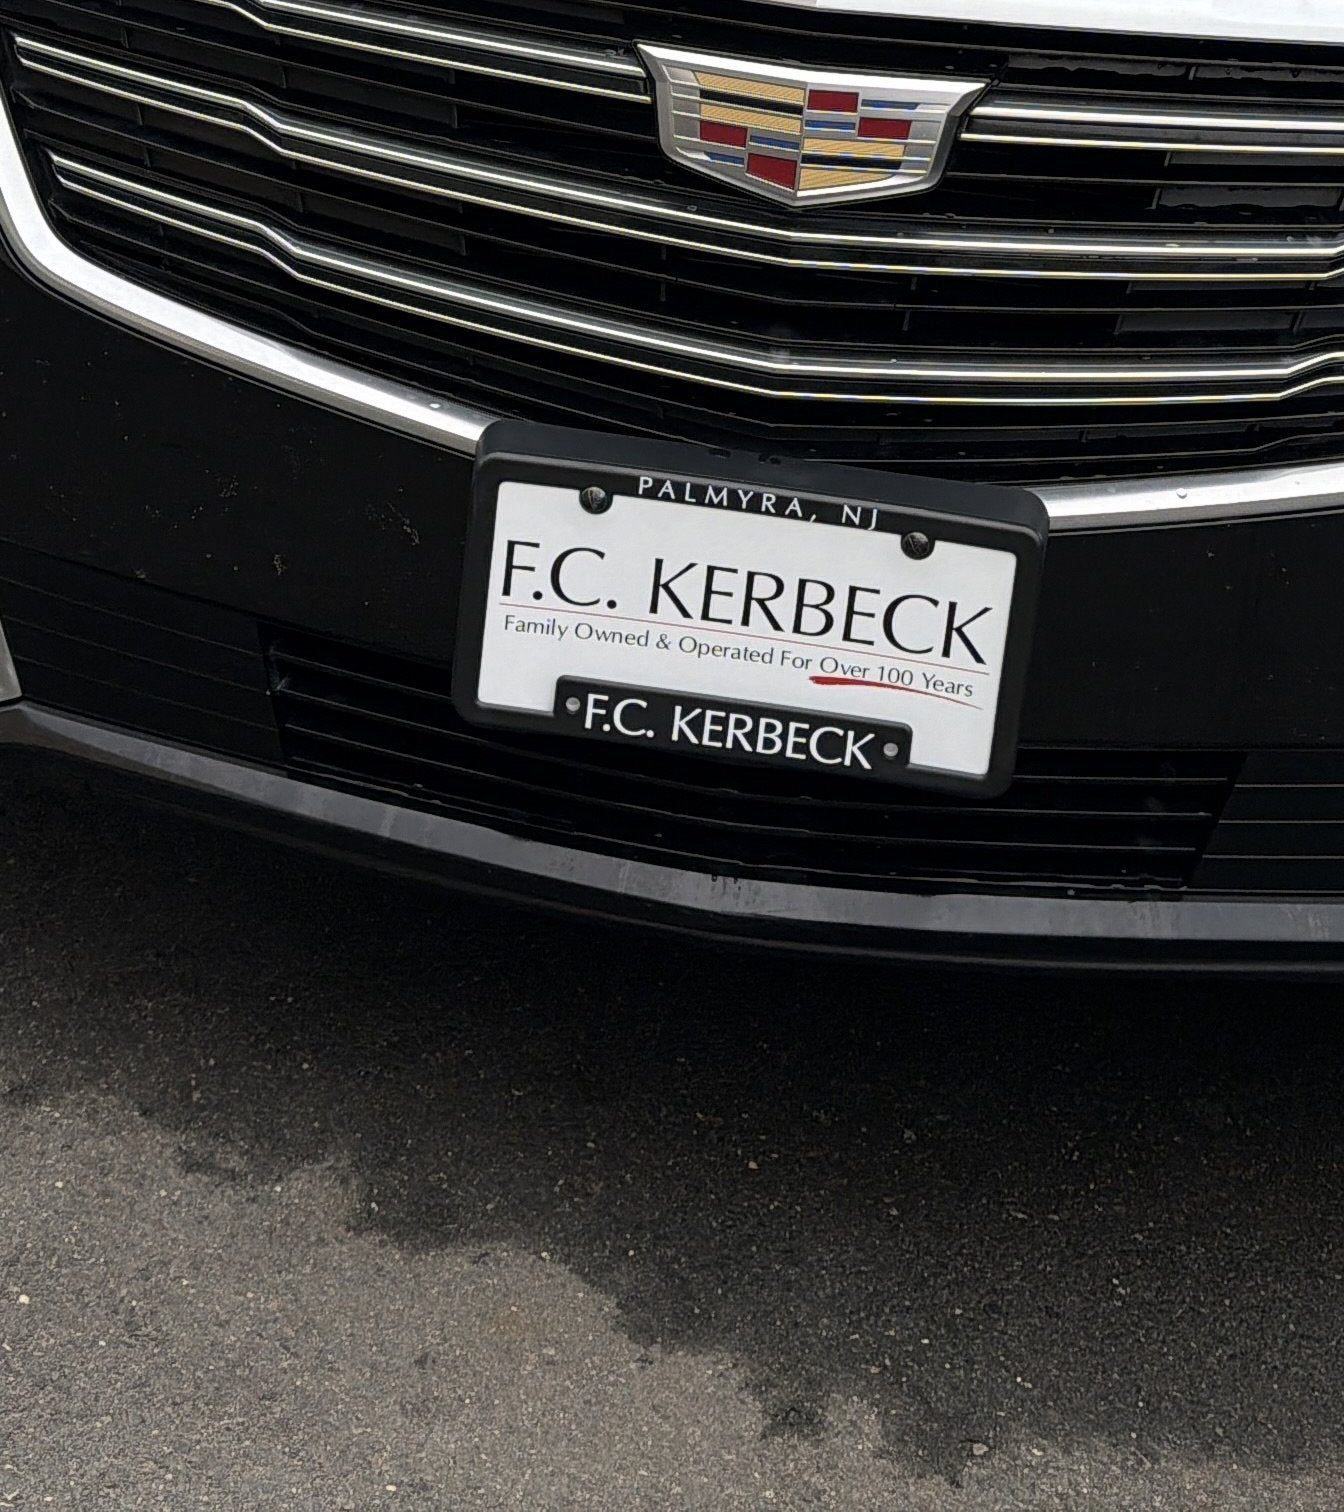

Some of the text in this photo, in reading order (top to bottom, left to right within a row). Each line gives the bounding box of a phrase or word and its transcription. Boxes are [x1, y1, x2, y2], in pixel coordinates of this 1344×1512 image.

[637, 476, 881, 531] PALMYRA, NJ
[501, 539, 994, 665] F.C. KERBECK
[503, 614, 974, 698] Family Owned & Operated For Over 100 Years
[584, 693, 876, 770] F.C. KERBECK
